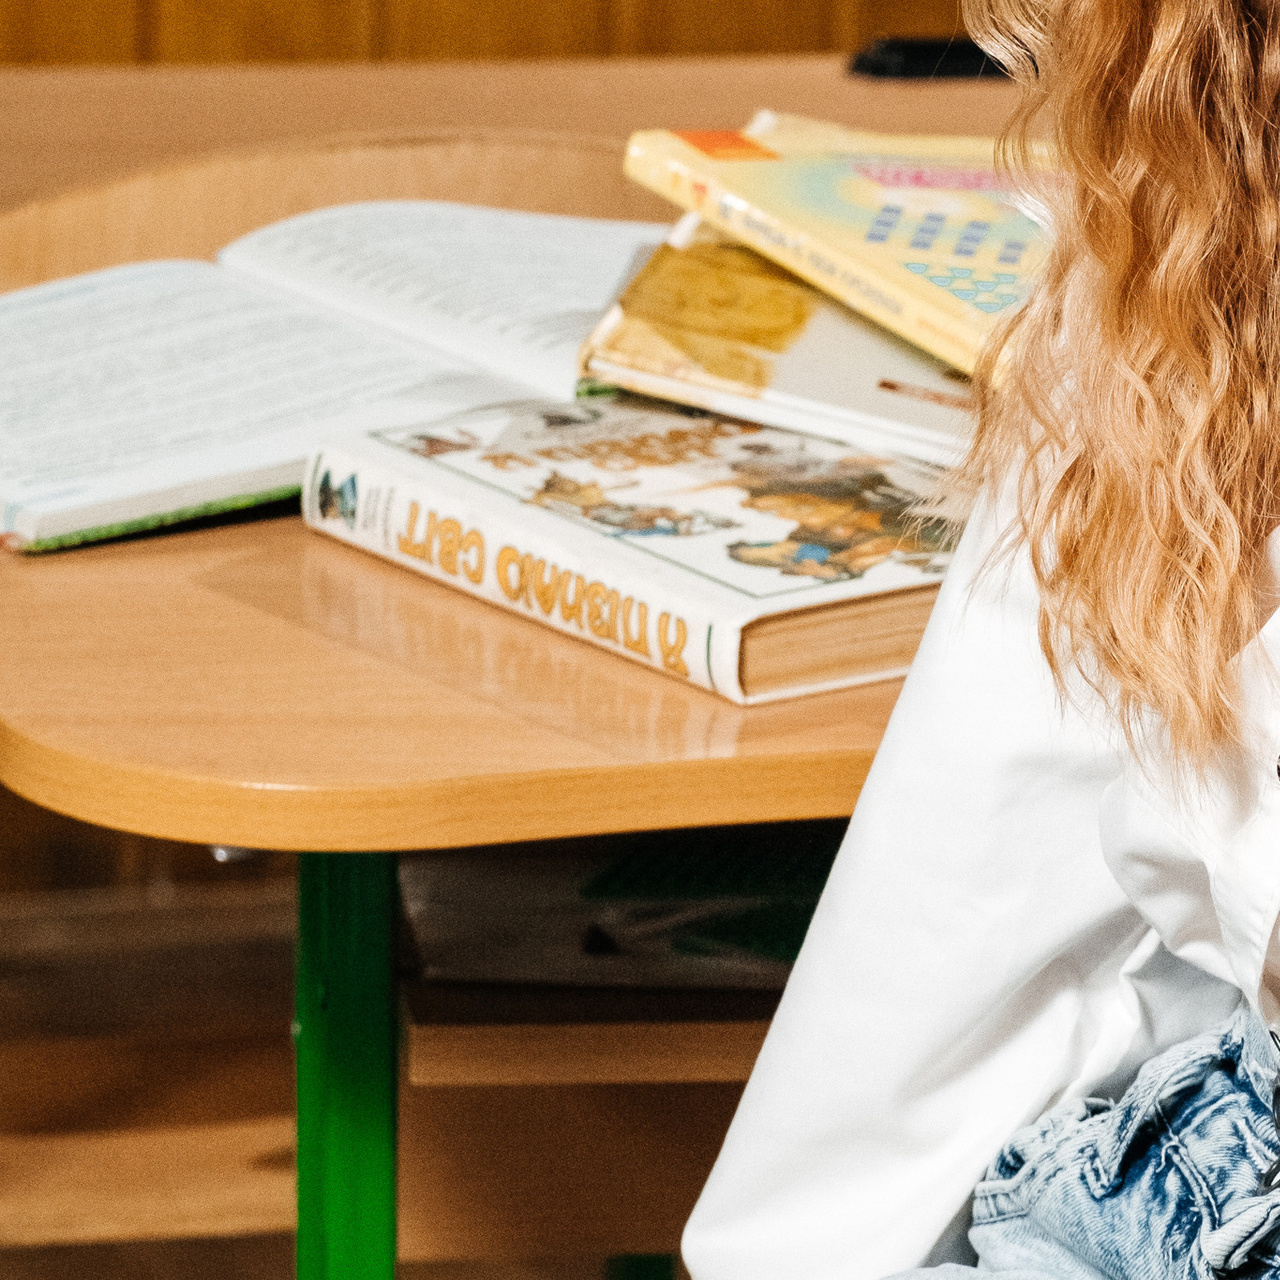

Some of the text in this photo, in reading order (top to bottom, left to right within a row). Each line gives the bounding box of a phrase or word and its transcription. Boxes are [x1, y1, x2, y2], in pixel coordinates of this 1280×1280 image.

[397, 501, 485, 586] СВІТ
[496, 546, 652, 661] ПІЗНАЮ
[657, 612, 690, 680] Я
